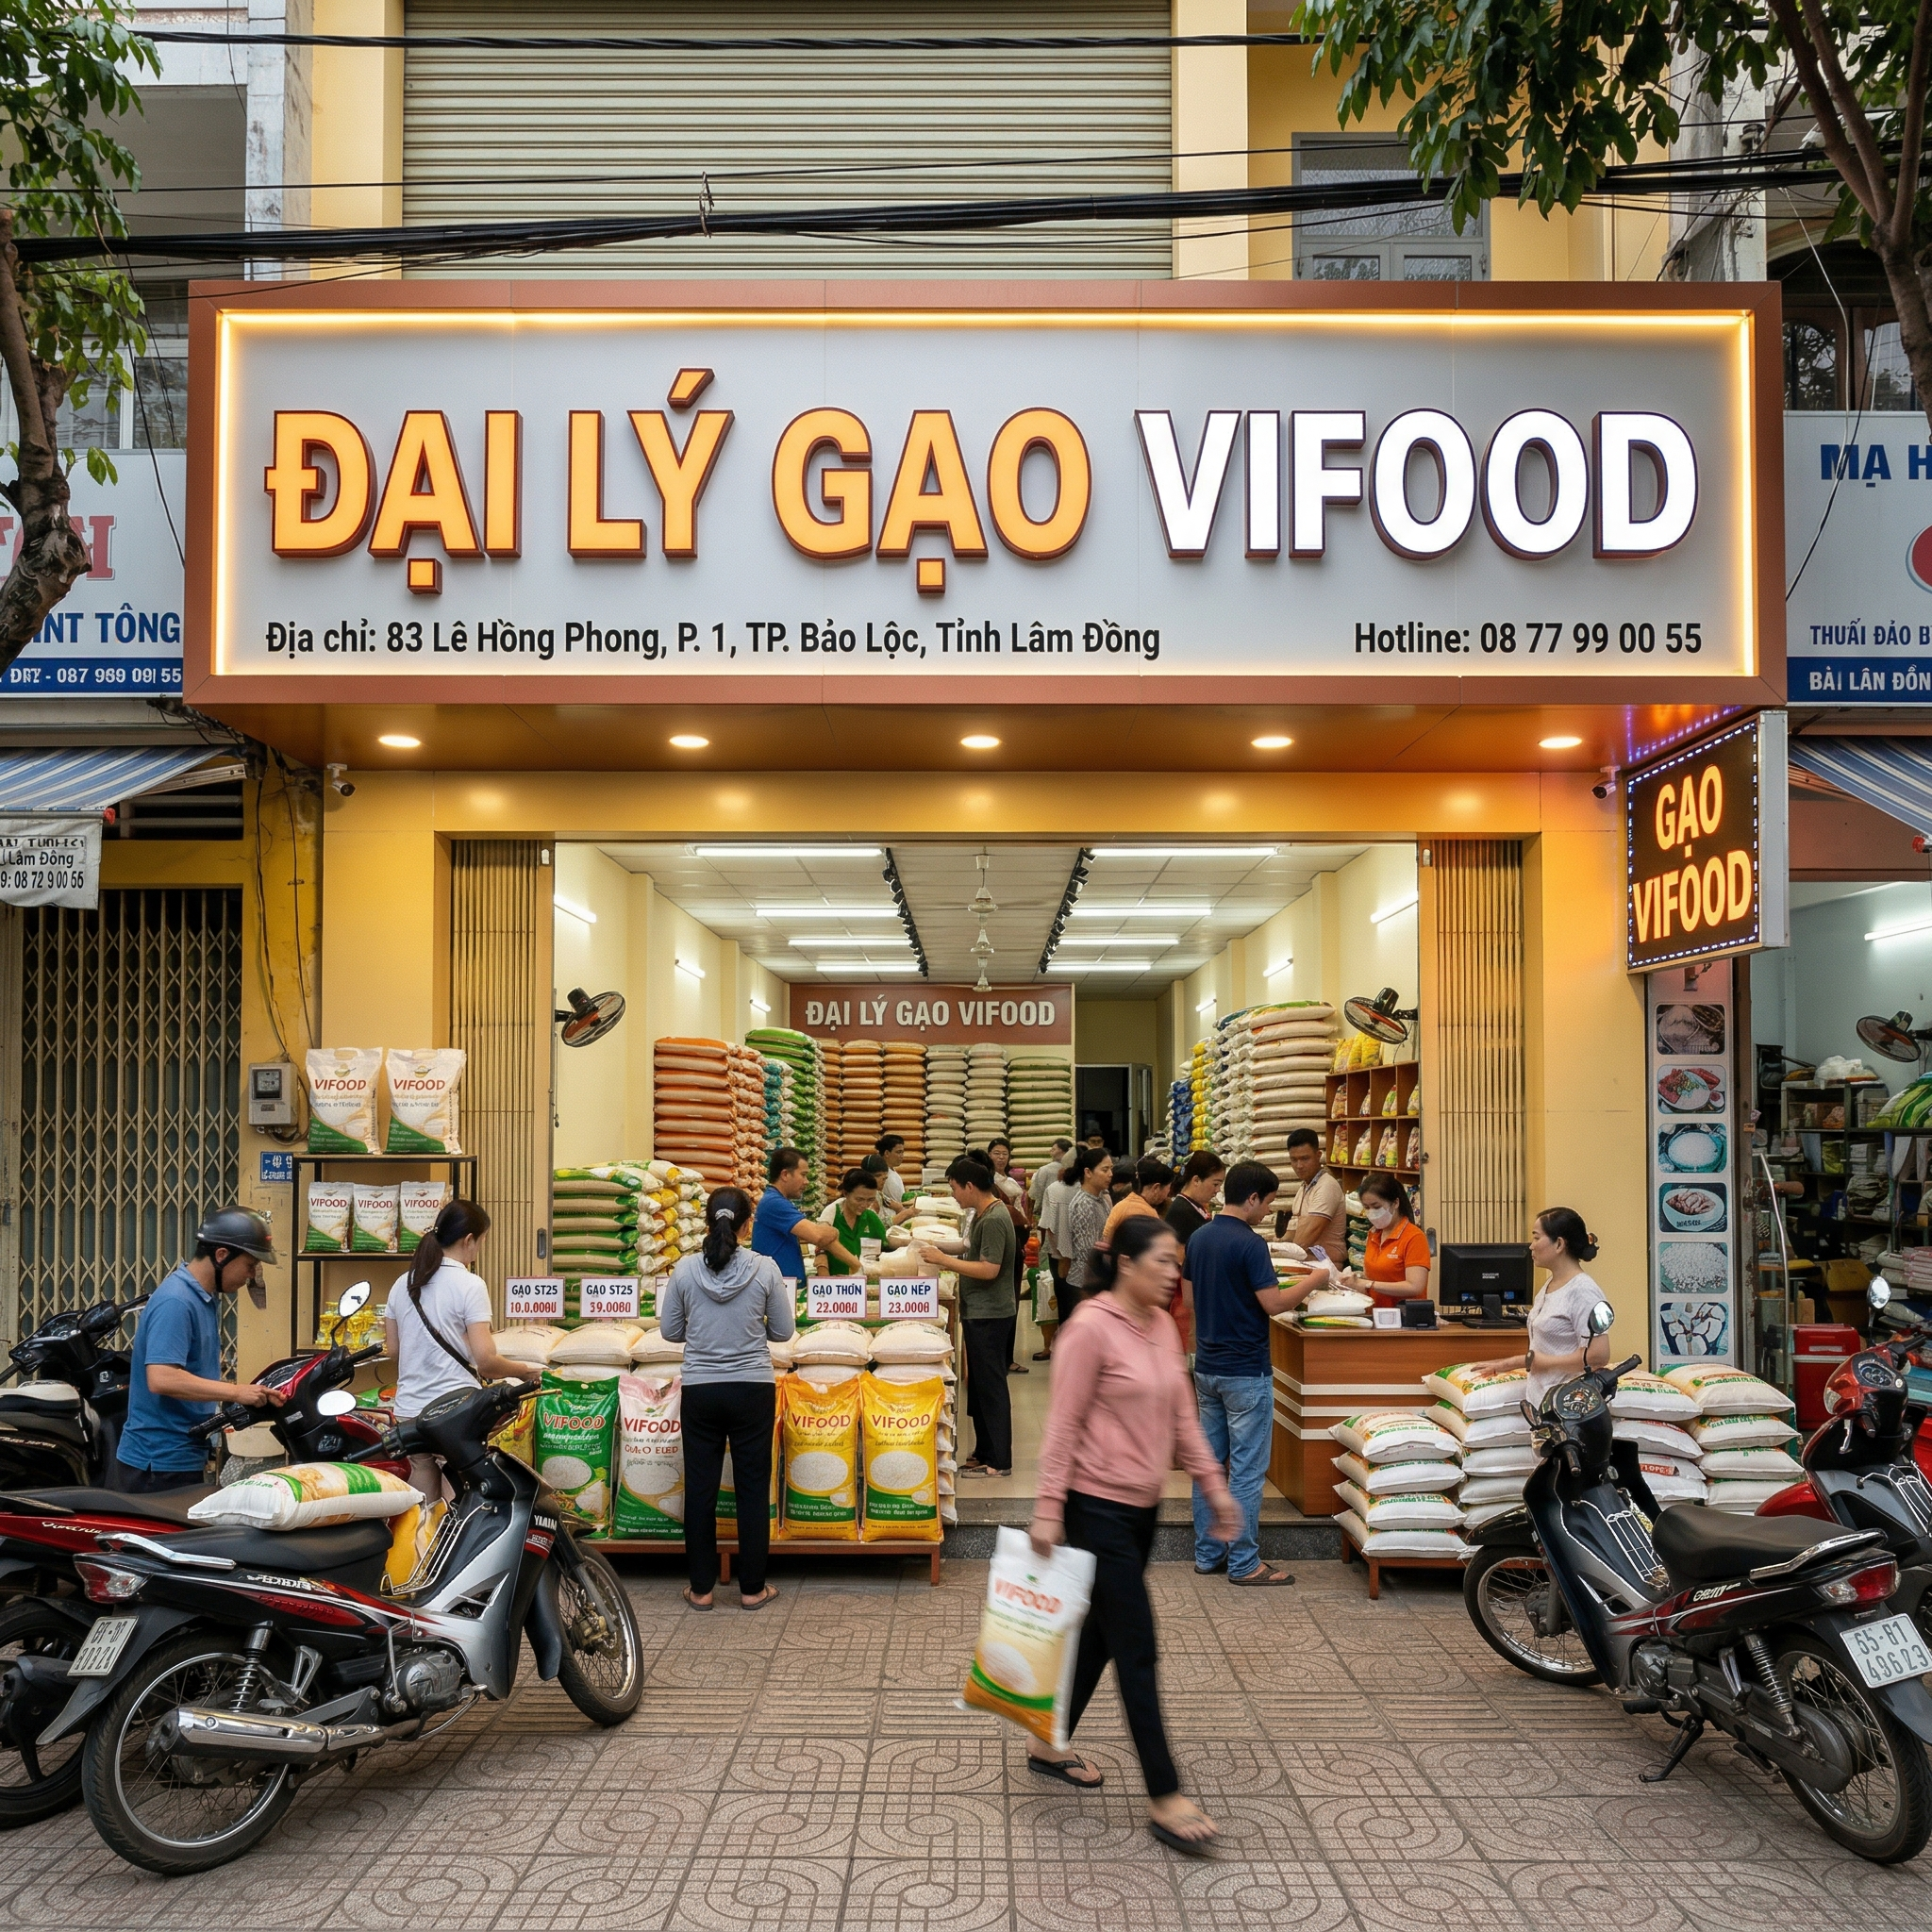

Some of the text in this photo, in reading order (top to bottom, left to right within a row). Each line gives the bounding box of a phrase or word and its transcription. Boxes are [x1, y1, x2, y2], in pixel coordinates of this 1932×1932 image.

[264, 368, 1697, 595] ĐẠI LÝ GẠO VIFOOD
[94, 602, 180, 644] TÔNG
[265, 618, 1160, 660] Địa chỉ: 83 Lê Hồng Phong, P. 1, TP. Bảo Lộc, Tỉnh Lâm Đồng
[1355, 622, 1702, 654] Hotline: 08 77 99 00 55
[57, 668, 89, 683] 087
[160, 668, 182, 683] 55
[1849, 667, 1886, 691] LÂN
[1655, 763, 1724, 858] GẠO
[8, 850, 36, 866] Lâm
[14, 871, 28, 889] 08
[31, 871, 44, 889] 72
[57, 871, 69, 889] 00
[1632, 849, 1753, 943] VIFOOD
[805, 993, 1056, 1031] ĐẠI LÝ GẠO VIFOOD
[314, 1078, 367, 1091] VIFOOD
[393, 1078, 446, 1091] VIFOOD
[534, 1285, 558, 1295] ST25
[608, 1285, 633, 1295] ST25
[543, 1412, 606, 1431] VIFOOD
[624, 1417, 681, 1434] VIFOOD
[791, 1413, 851, 1428] VIFOOD
[872, 1413, 931, 1429] VIFOOD
